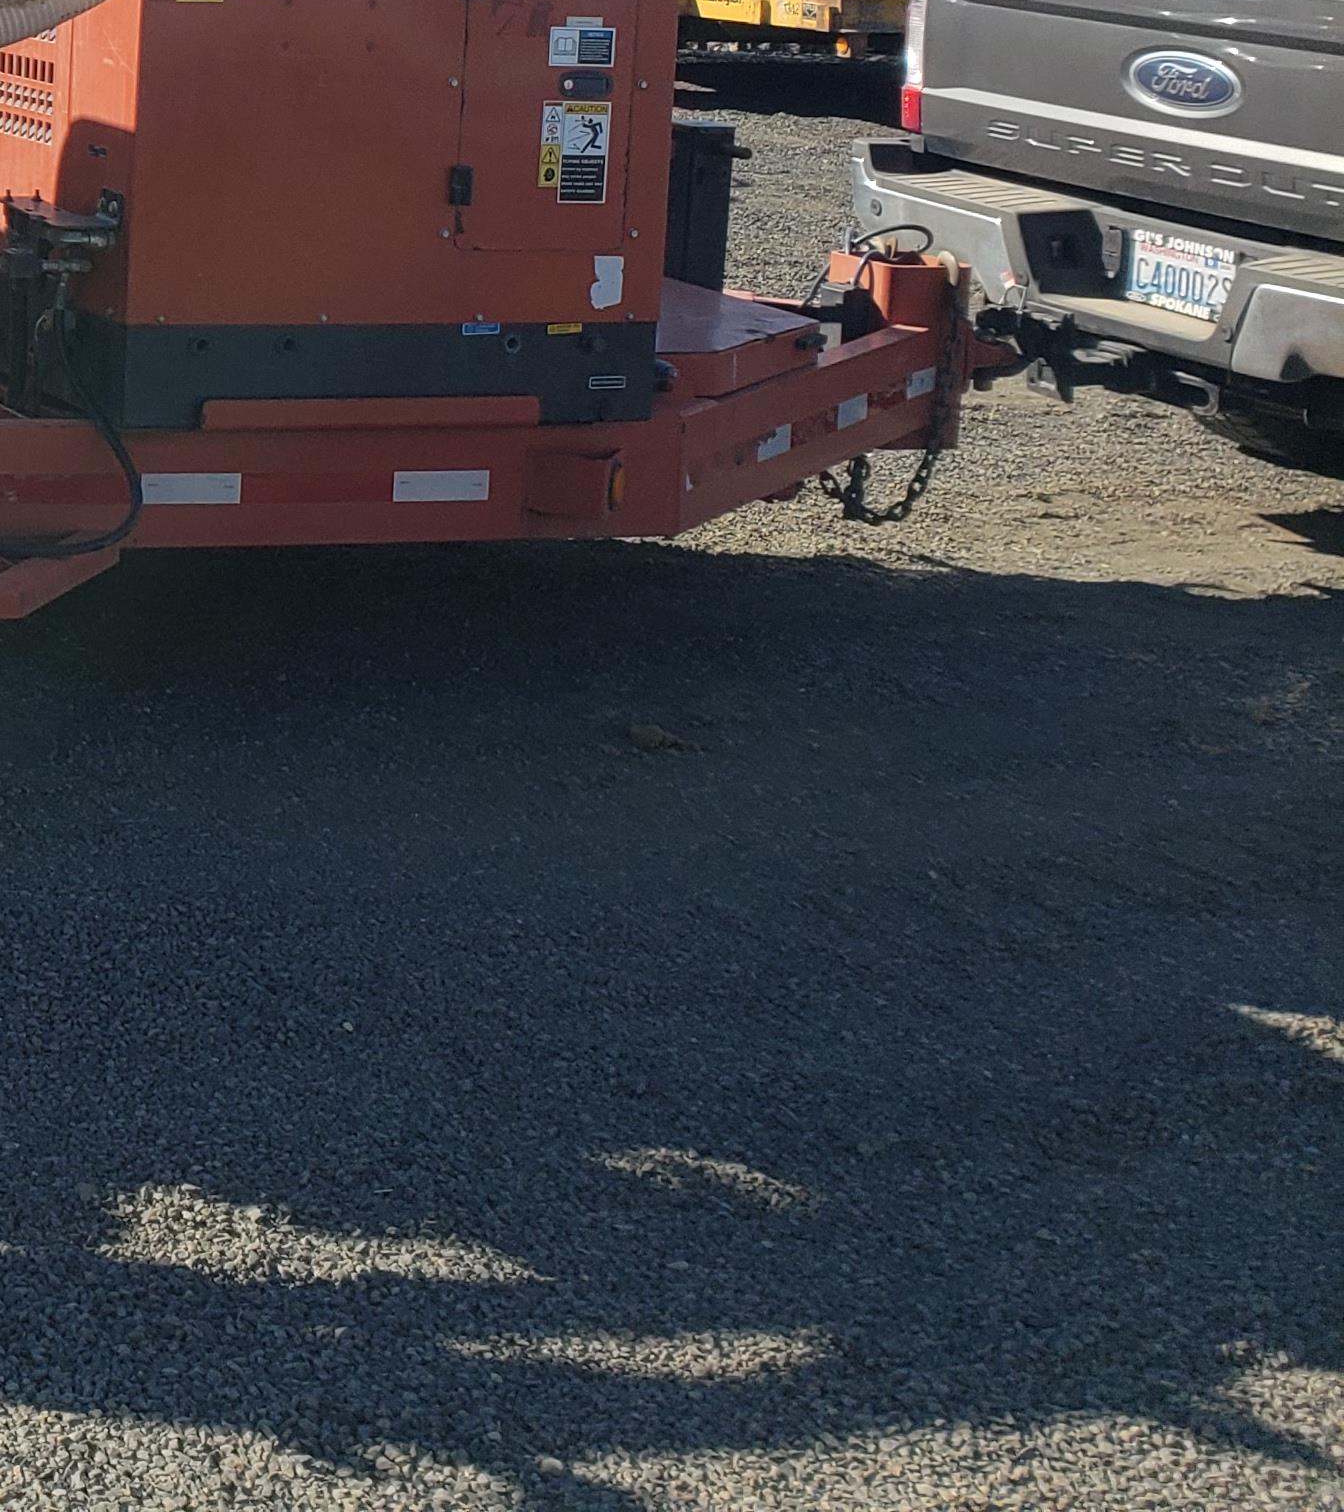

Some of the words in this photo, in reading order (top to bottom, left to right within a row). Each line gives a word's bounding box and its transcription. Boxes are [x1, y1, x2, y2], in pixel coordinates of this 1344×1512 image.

[1151, 61, 1211, 101] Ford
[573, 105, 608, 113] CAUTION
[986, 119, 1192, 177] SUPER
[1167, 236, 1235, 264] JOHNSON
[1149, 293, 1211, 320] SPOKANE
